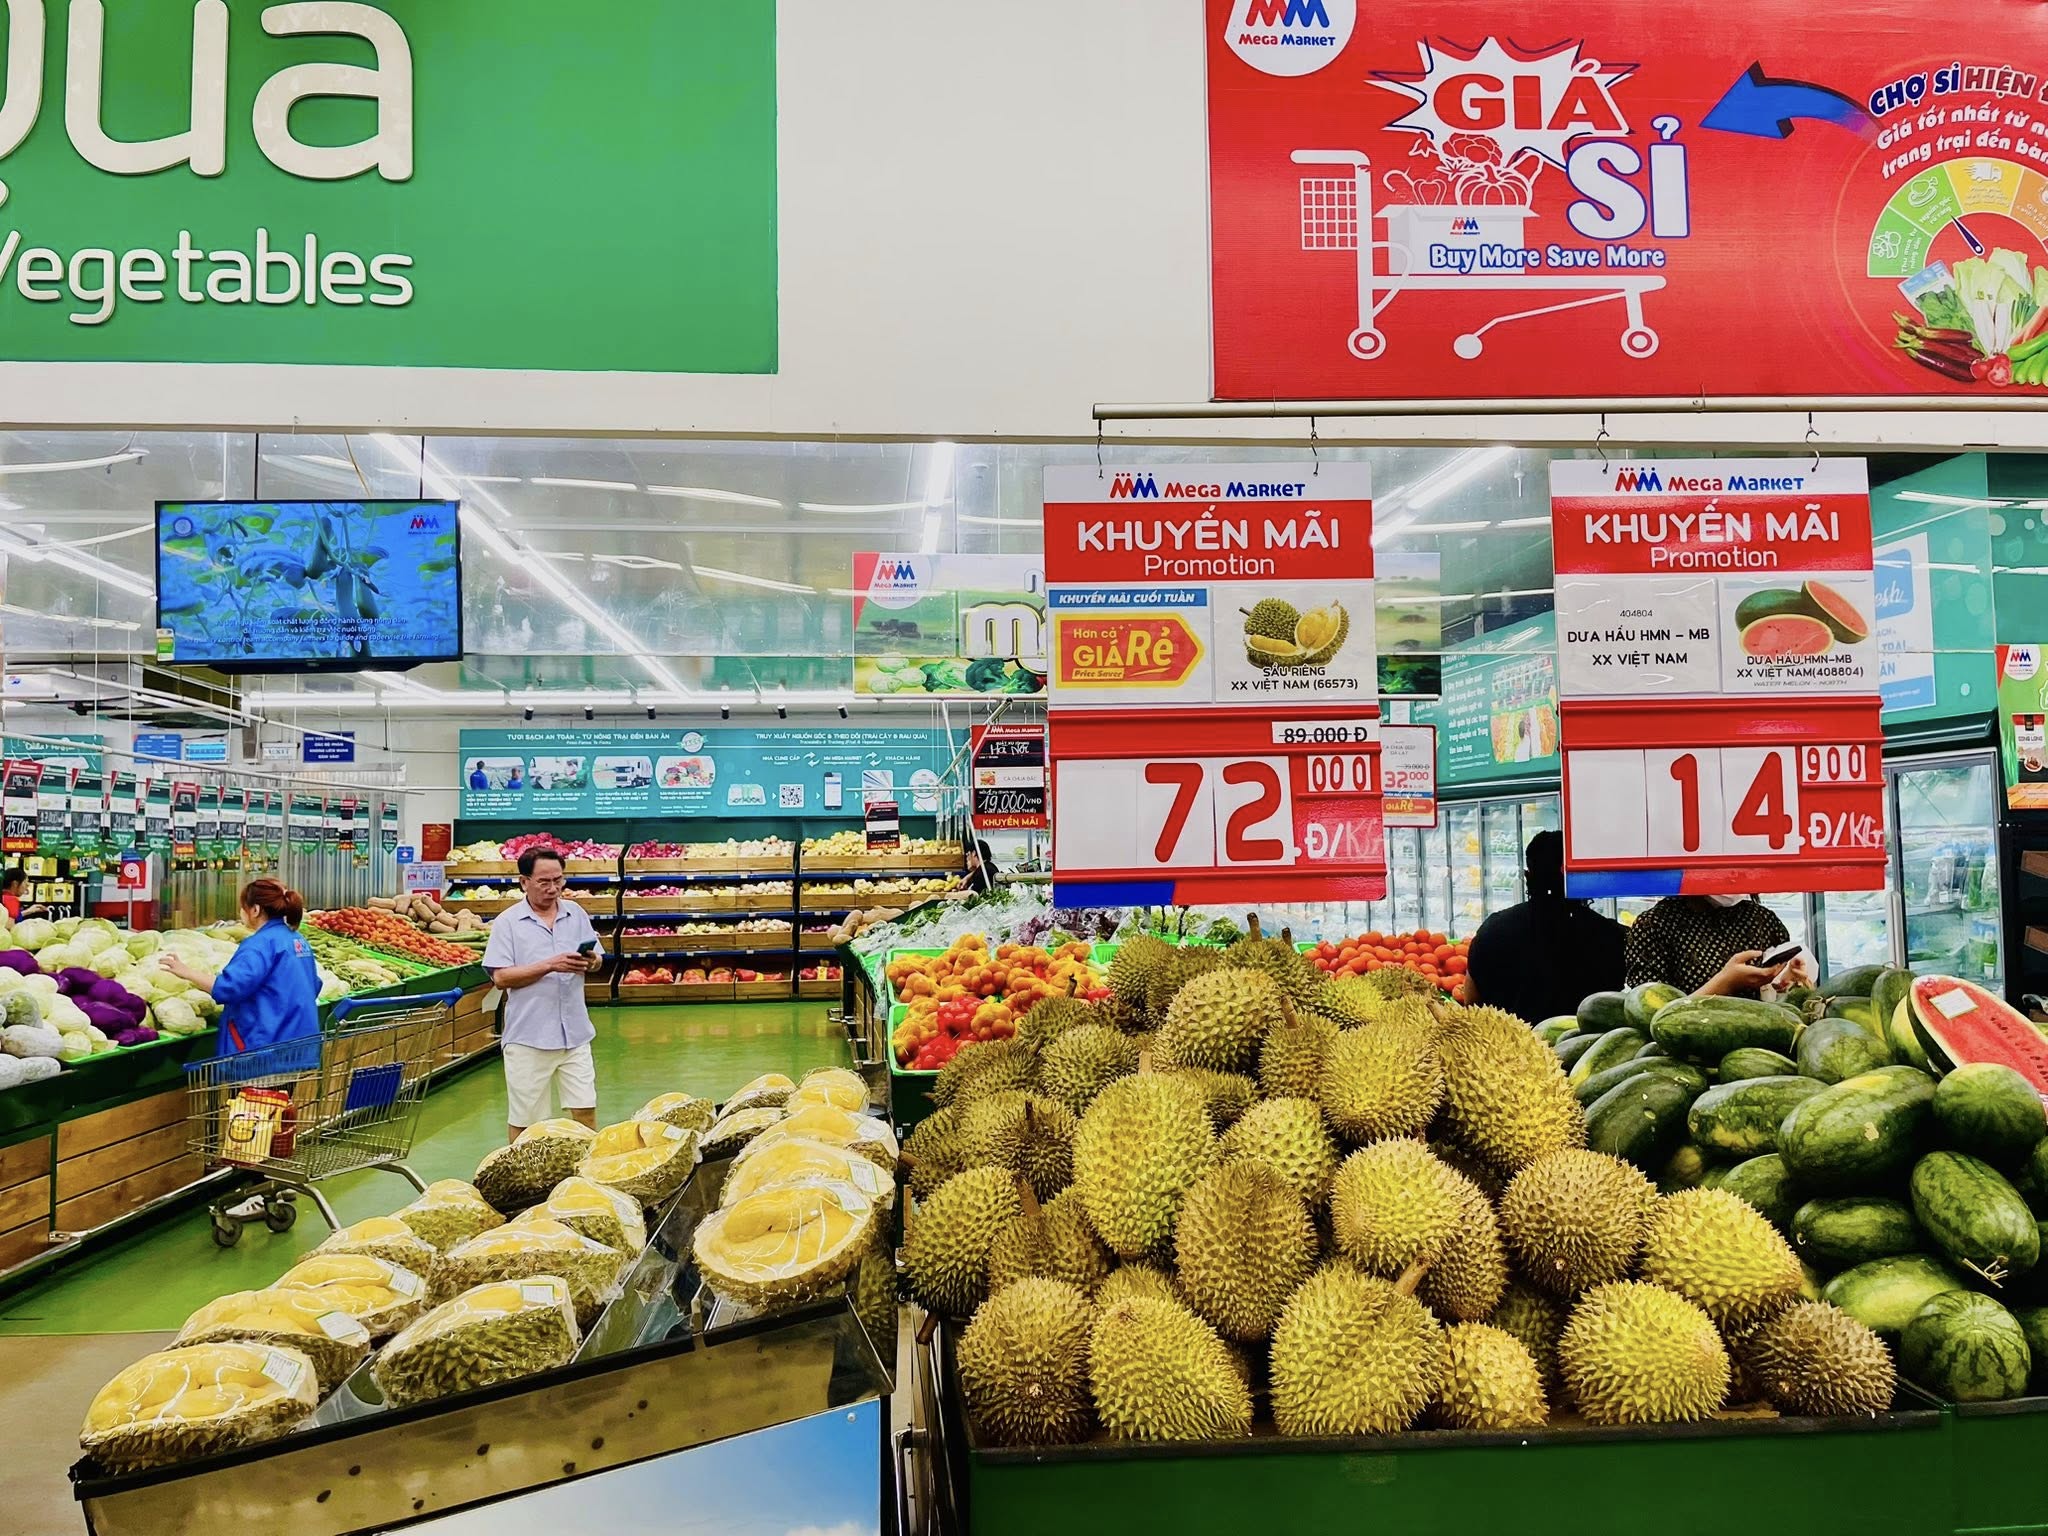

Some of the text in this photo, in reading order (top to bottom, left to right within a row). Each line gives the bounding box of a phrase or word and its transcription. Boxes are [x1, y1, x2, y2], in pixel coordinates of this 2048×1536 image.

[1433, 58, 1624, 132] GIÁ
[1870, 72, 1928, 117] CHỢ
[1933, 61, 1961, 95] SỈ
[1963, 64, 2037, 98] HIỆN
[1877, 117, 1913, 149] Giá
[1917, 104, 1947, 131] tốt
[1950, 101, 2000, 123] nhất
[2004, 110, 2031, 128] từ
[1882, 142, 1932, 179] trang
[1936, 129, 1972, 153] trại
[1975, 128, 2012, 150] đến
[1567, 115, 1691, 241] SỈ
[1430, 244, 1667, 275] Buy More Save More
[1077, 505, 1340, 551] KHUYẾN MÃI
[1584, 498, 1840, 544] KHUYẾN MÃI
[1144, 553, 1275, 576] Promotion
[1650, 546, 1778, 569] Promotion
[1059, 590, 1196, 605] KHUYẾN MÃI CUỐI TUẦN
[1619, 608, 1654, 618] 404804
[1073, 626, 1118, 640] Hơn cả
[1567, 628, 1601, 643] DƯA
[1605, 624, 1636, 643] HẤU
[1640, 627, 1672, 643] HMN
[1689, 627, 1711, 641] MB
[1072, 626, 1175, 668] GIÁ Rẻ
[1746, 655, 1773, 666] DƯA
[1776, 651, 1802, 665] HẤU
[1292, 664, 1326, 677] RIÊNG
[1592, 650, 1689, 669] XX VIỆT NAM
[1073, 668, 1123, 680] Price Saver
[1736, 668, 1754, 679] XX
[1756, 665, 1783, 682] VIỆT
[1231, 679, 1359, 693] XX VIỆT NAM (66573)
[1283, 726, 1349, 744] 89.000
[1144, 760, 1285, 864] 72
[1311, 755, 1369, 792] 000
[1670, 751, 1794, 853] 14
[1807, 744, 1862, 782] 900
[983, 815, 1040, 827] KHUYẾN MÃI
